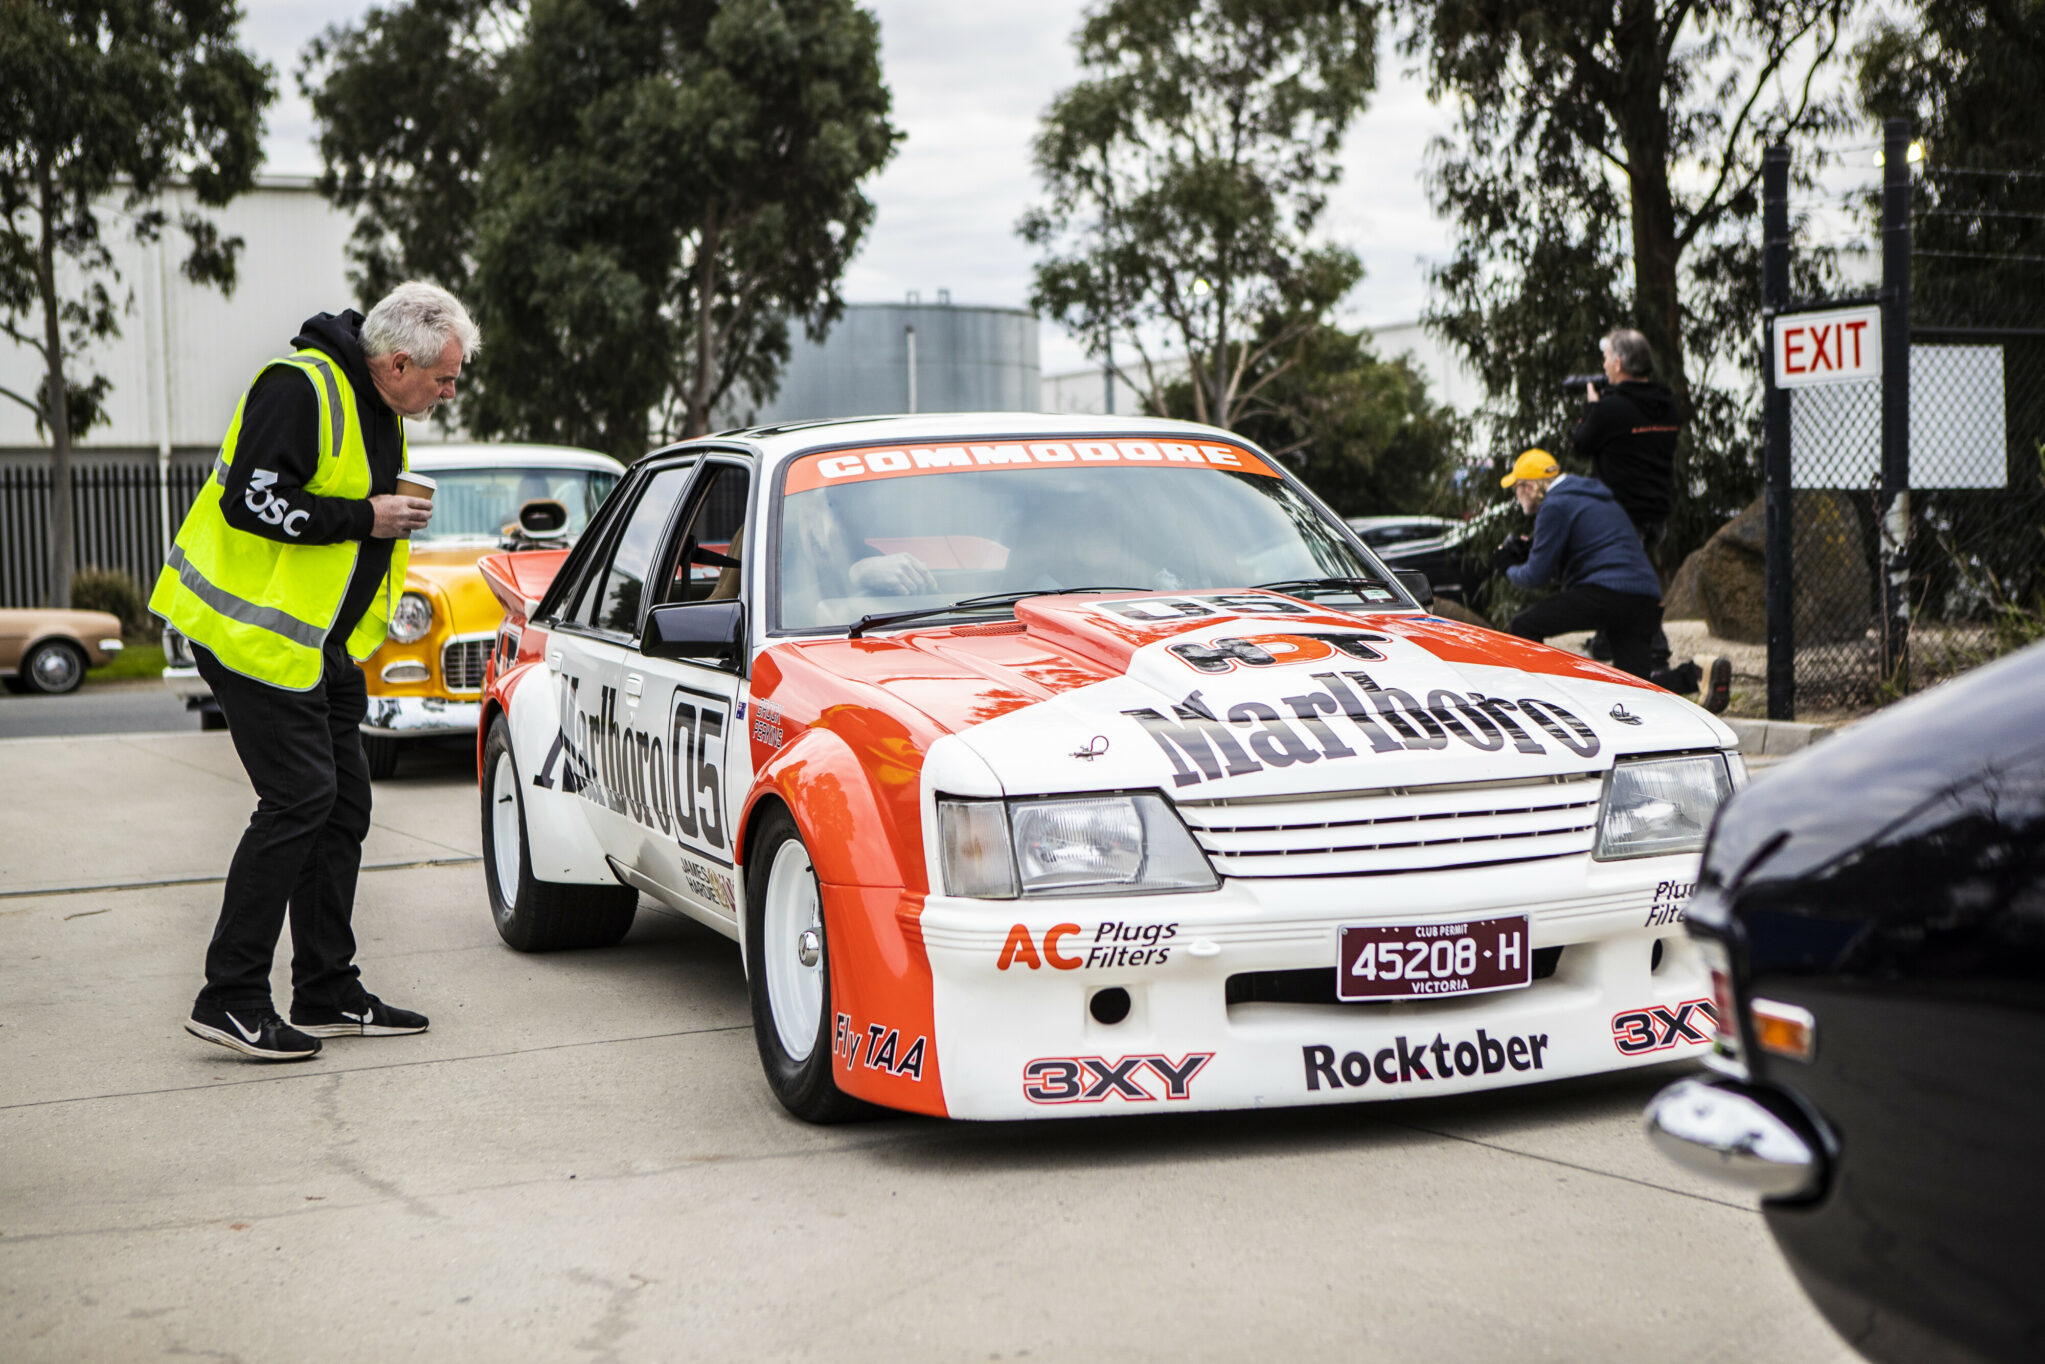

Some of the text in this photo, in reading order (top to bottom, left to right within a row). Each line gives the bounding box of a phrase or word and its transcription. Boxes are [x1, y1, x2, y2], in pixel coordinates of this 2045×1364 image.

[1785, 321, 1868, 375] EXIT
[818, 441, 1242, 479] COMMODORE
[1166, 632, 1392, 675] HDT
[753, 719, 784, 750] PERKINS
[1120, 671, 1601, 789] Marlboro
[533, 673, 671, 836] Marlboro
[672, 702, 726, 850] 05
[680, 856, 710, 884] JAMES
[685, 875, 720, 905] HARDIE
[1094, 921, 1179, 947] Plugs
[1415, 923, 1469, 937] CLUB PERMIT
[1644, 903, 1686, 928] Filte
[997, 923, 1083, 970] AC
[1085, 946, 1170, 969] Filters
[1411, 978, 1469, 993] VICTORIA
[834, 1012, 927, 1082] Fly TAA
[1302, 1028, 1549, 1092] Rocktober
[1023, 1052, 1217, 1105] 3XY
